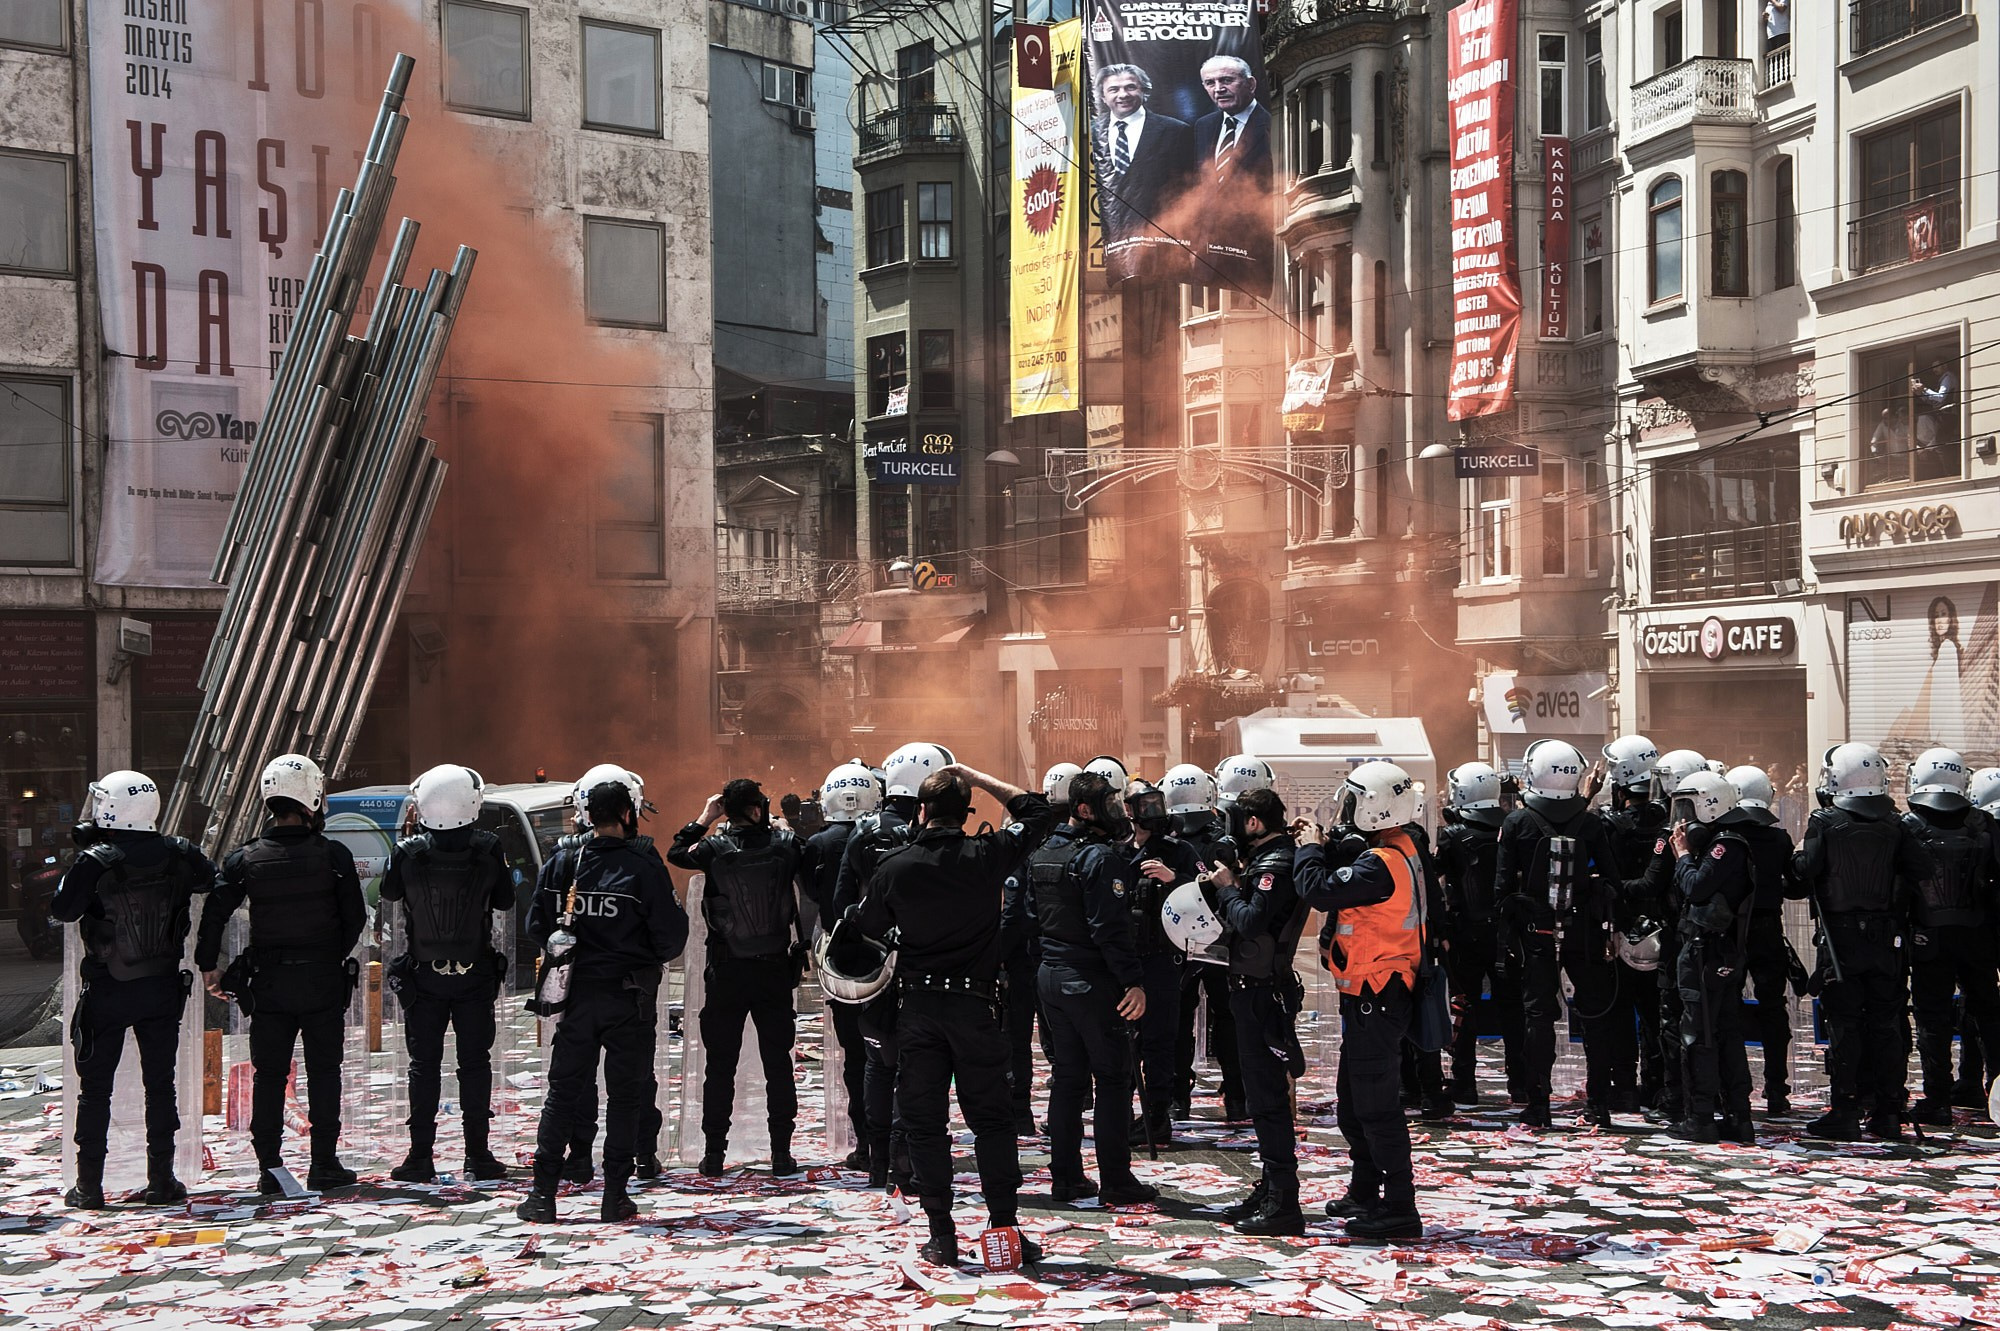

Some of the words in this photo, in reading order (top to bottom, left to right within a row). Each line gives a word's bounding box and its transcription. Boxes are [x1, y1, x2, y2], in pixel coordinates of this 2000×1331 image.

[1122, 25, 1214, 42] BEYOĞLU
[124, 24, 192, 64] MAYIS
[126, 63, 172, 99] 2014
[1023, 115, 1059, 138] Herkese
[1450, 155, 1501, 192] ERKEZİNDE
[1551, 147, 1564, 220] KANADA
[126, 119, 388, 260] YAŞI
[1453, 191, 1488, 221] DEVAM
[1547, 262, 1564, 336] KÜLTÜR
[131, 260, 235, 377] DA
[1055, 350, 1067, 363] 00
[1467, 358, 1480, 380] 90
[1480, 356, 1495, 378] 35
[216, 413, 260, 445] Yap
[881, 461, 957, 477] TURKCELL
[1459, 454, 1534, 469] TURKCELL
[1643, 624, 1700, 656] ÖZSÜT
[1727, 624, 1783, 651] CAFE
[1536, 690, 1581, 719] avea
[1053, 718, 1098, 731] SWAROVSKI
[1232, 766, 1258, 778] T-615
[1551, 765, 1578, 775] T-612
[1622, 769, 1635, 779] 34
[1931, 761, 1962, 774] T-703
[1169, 776, 1197, 788] T-342
[359, 799, 376, 808] 444
[376, 799, 382, 808] 0
[383, 799, 397, 808] 160
[102, 812, 116, 822] 34
[1378, 810, 1392, 821] 34
